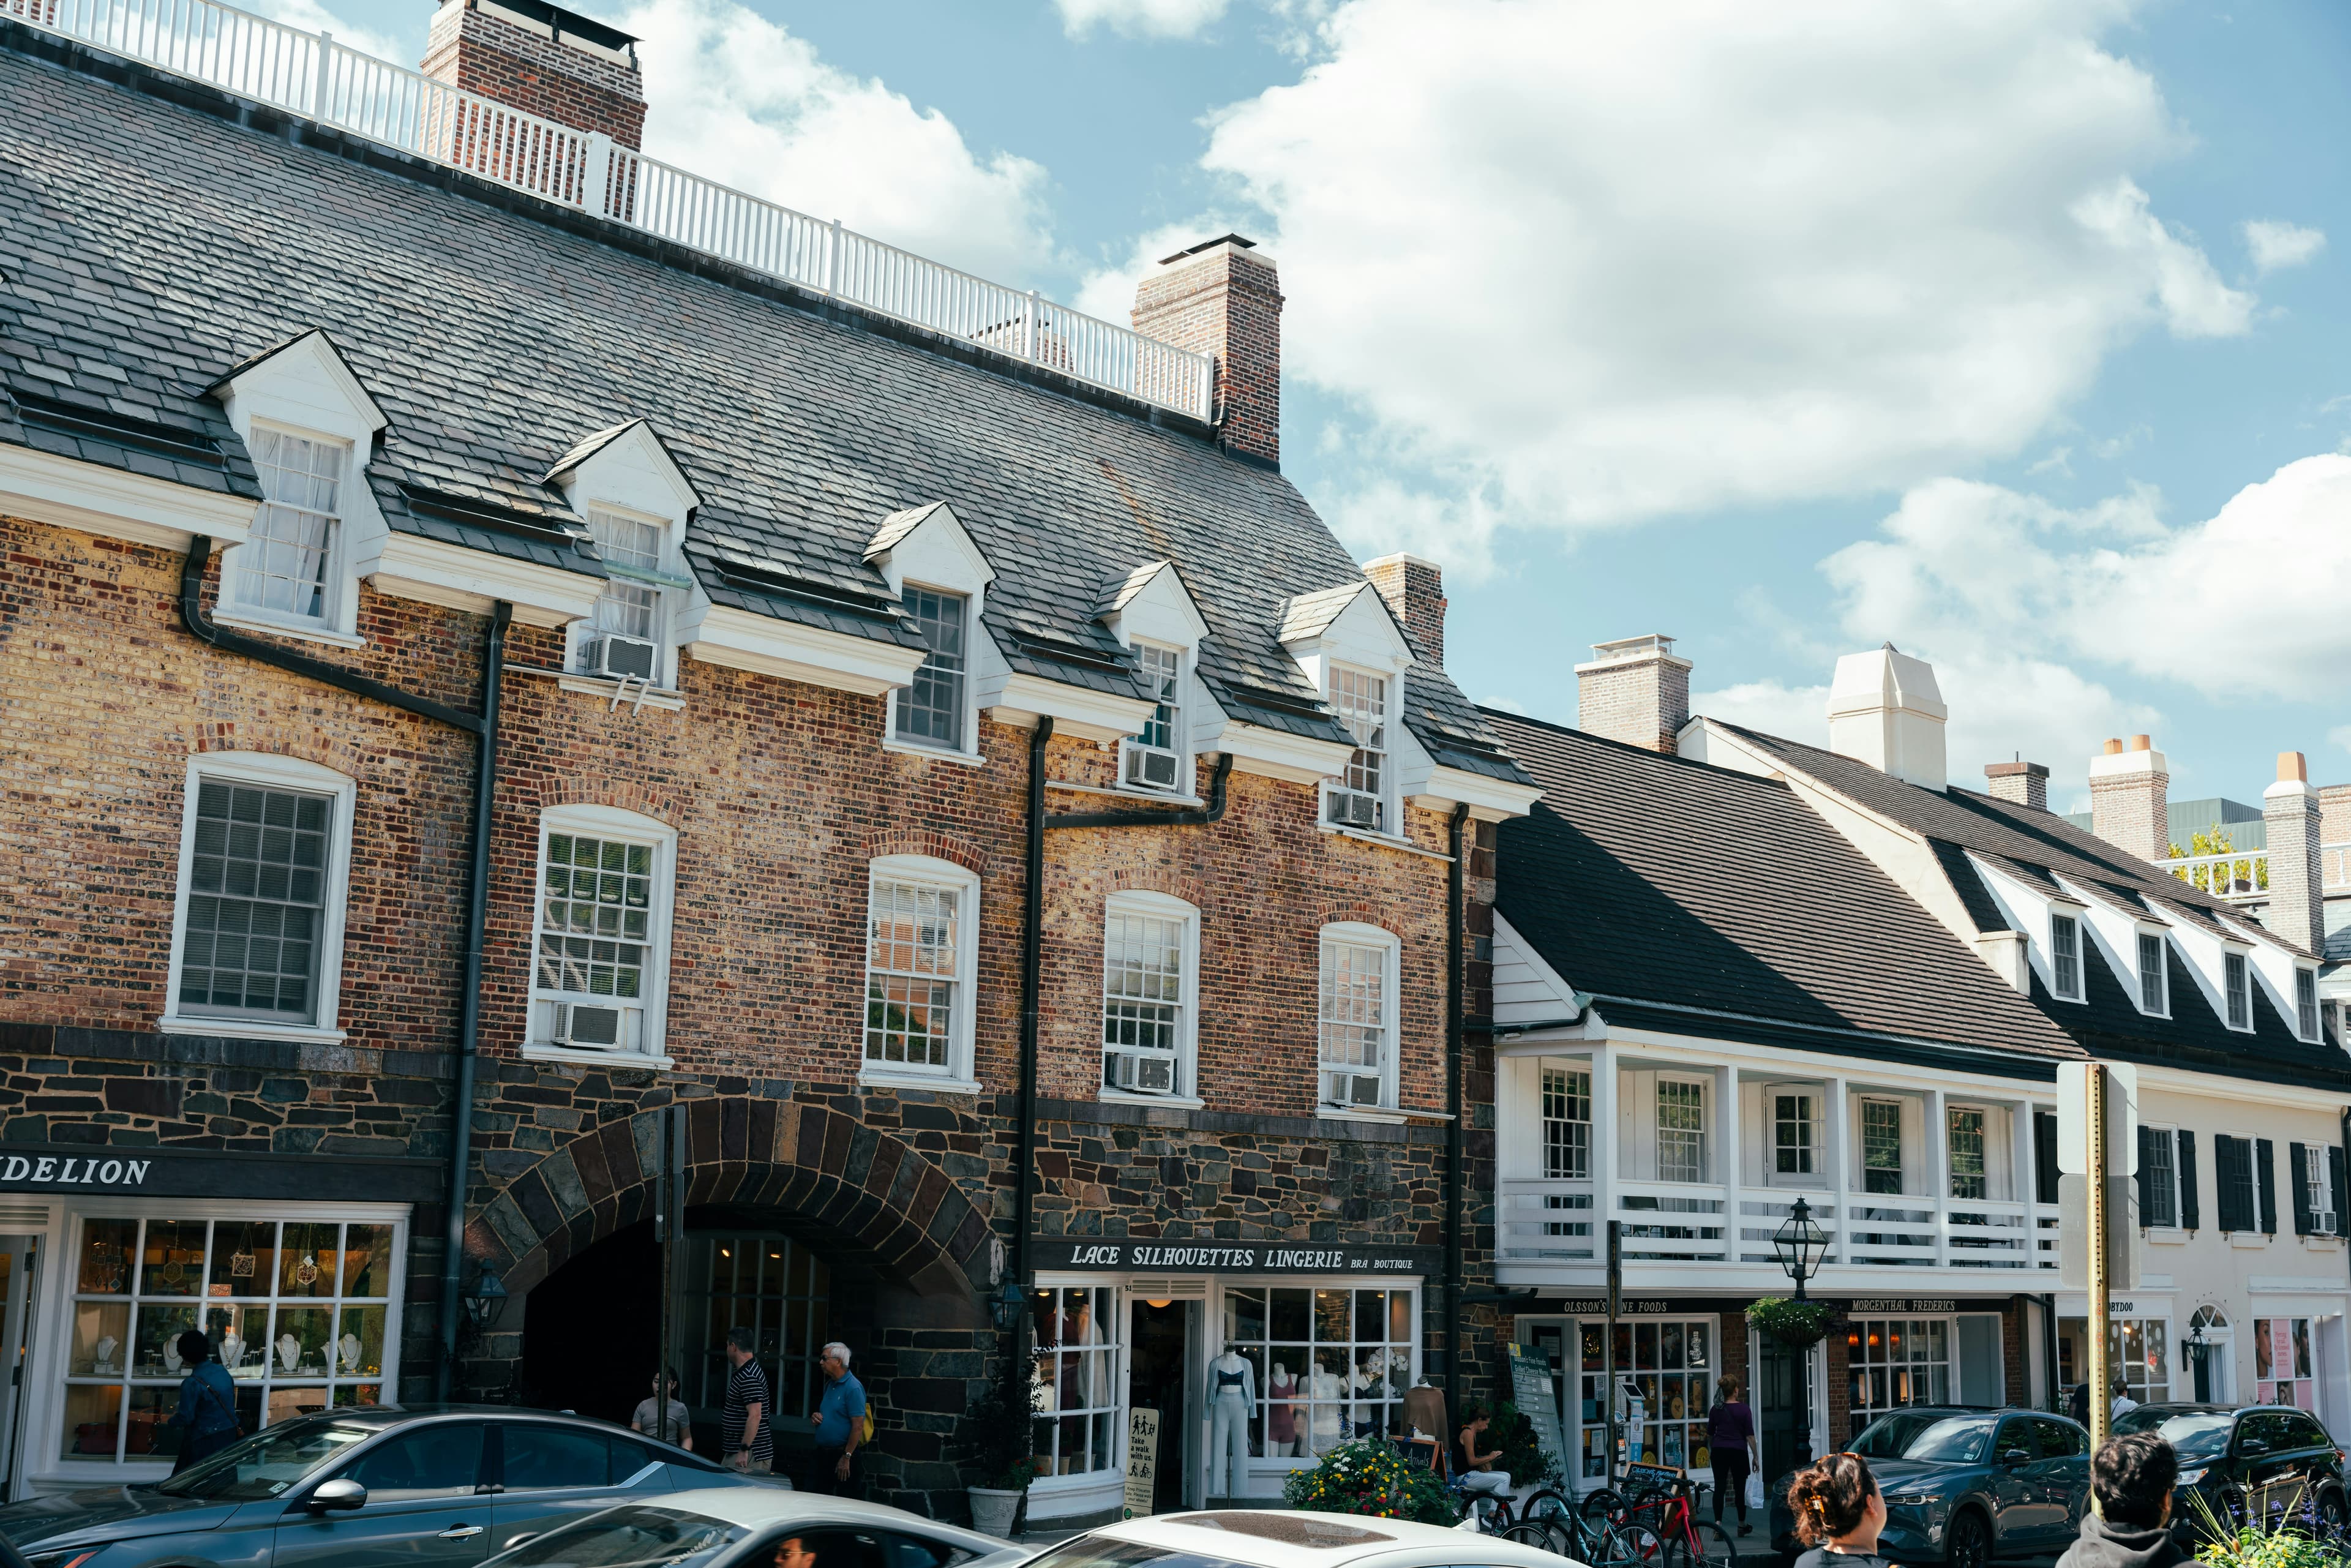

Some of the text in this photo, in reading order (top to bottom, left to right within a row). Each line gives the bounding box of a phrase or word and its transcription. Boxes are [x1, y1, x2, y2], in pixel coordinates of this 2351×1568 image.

[0, 1156, 151, 1185] DELION
[1070, 1245, 1413, 1269] LACE SILHOUETTES LINGERIE BRA BOUTIQUE
[1564, 1299, 1667, 1312] OLSSON'S NE FOODS
[1852, 1299, 1955, 1311] MORGENTHAL FREDERICS
[2109, 1302, 2133, 1312] BYDOO
[1130, 1452, 1143, 1460] with
